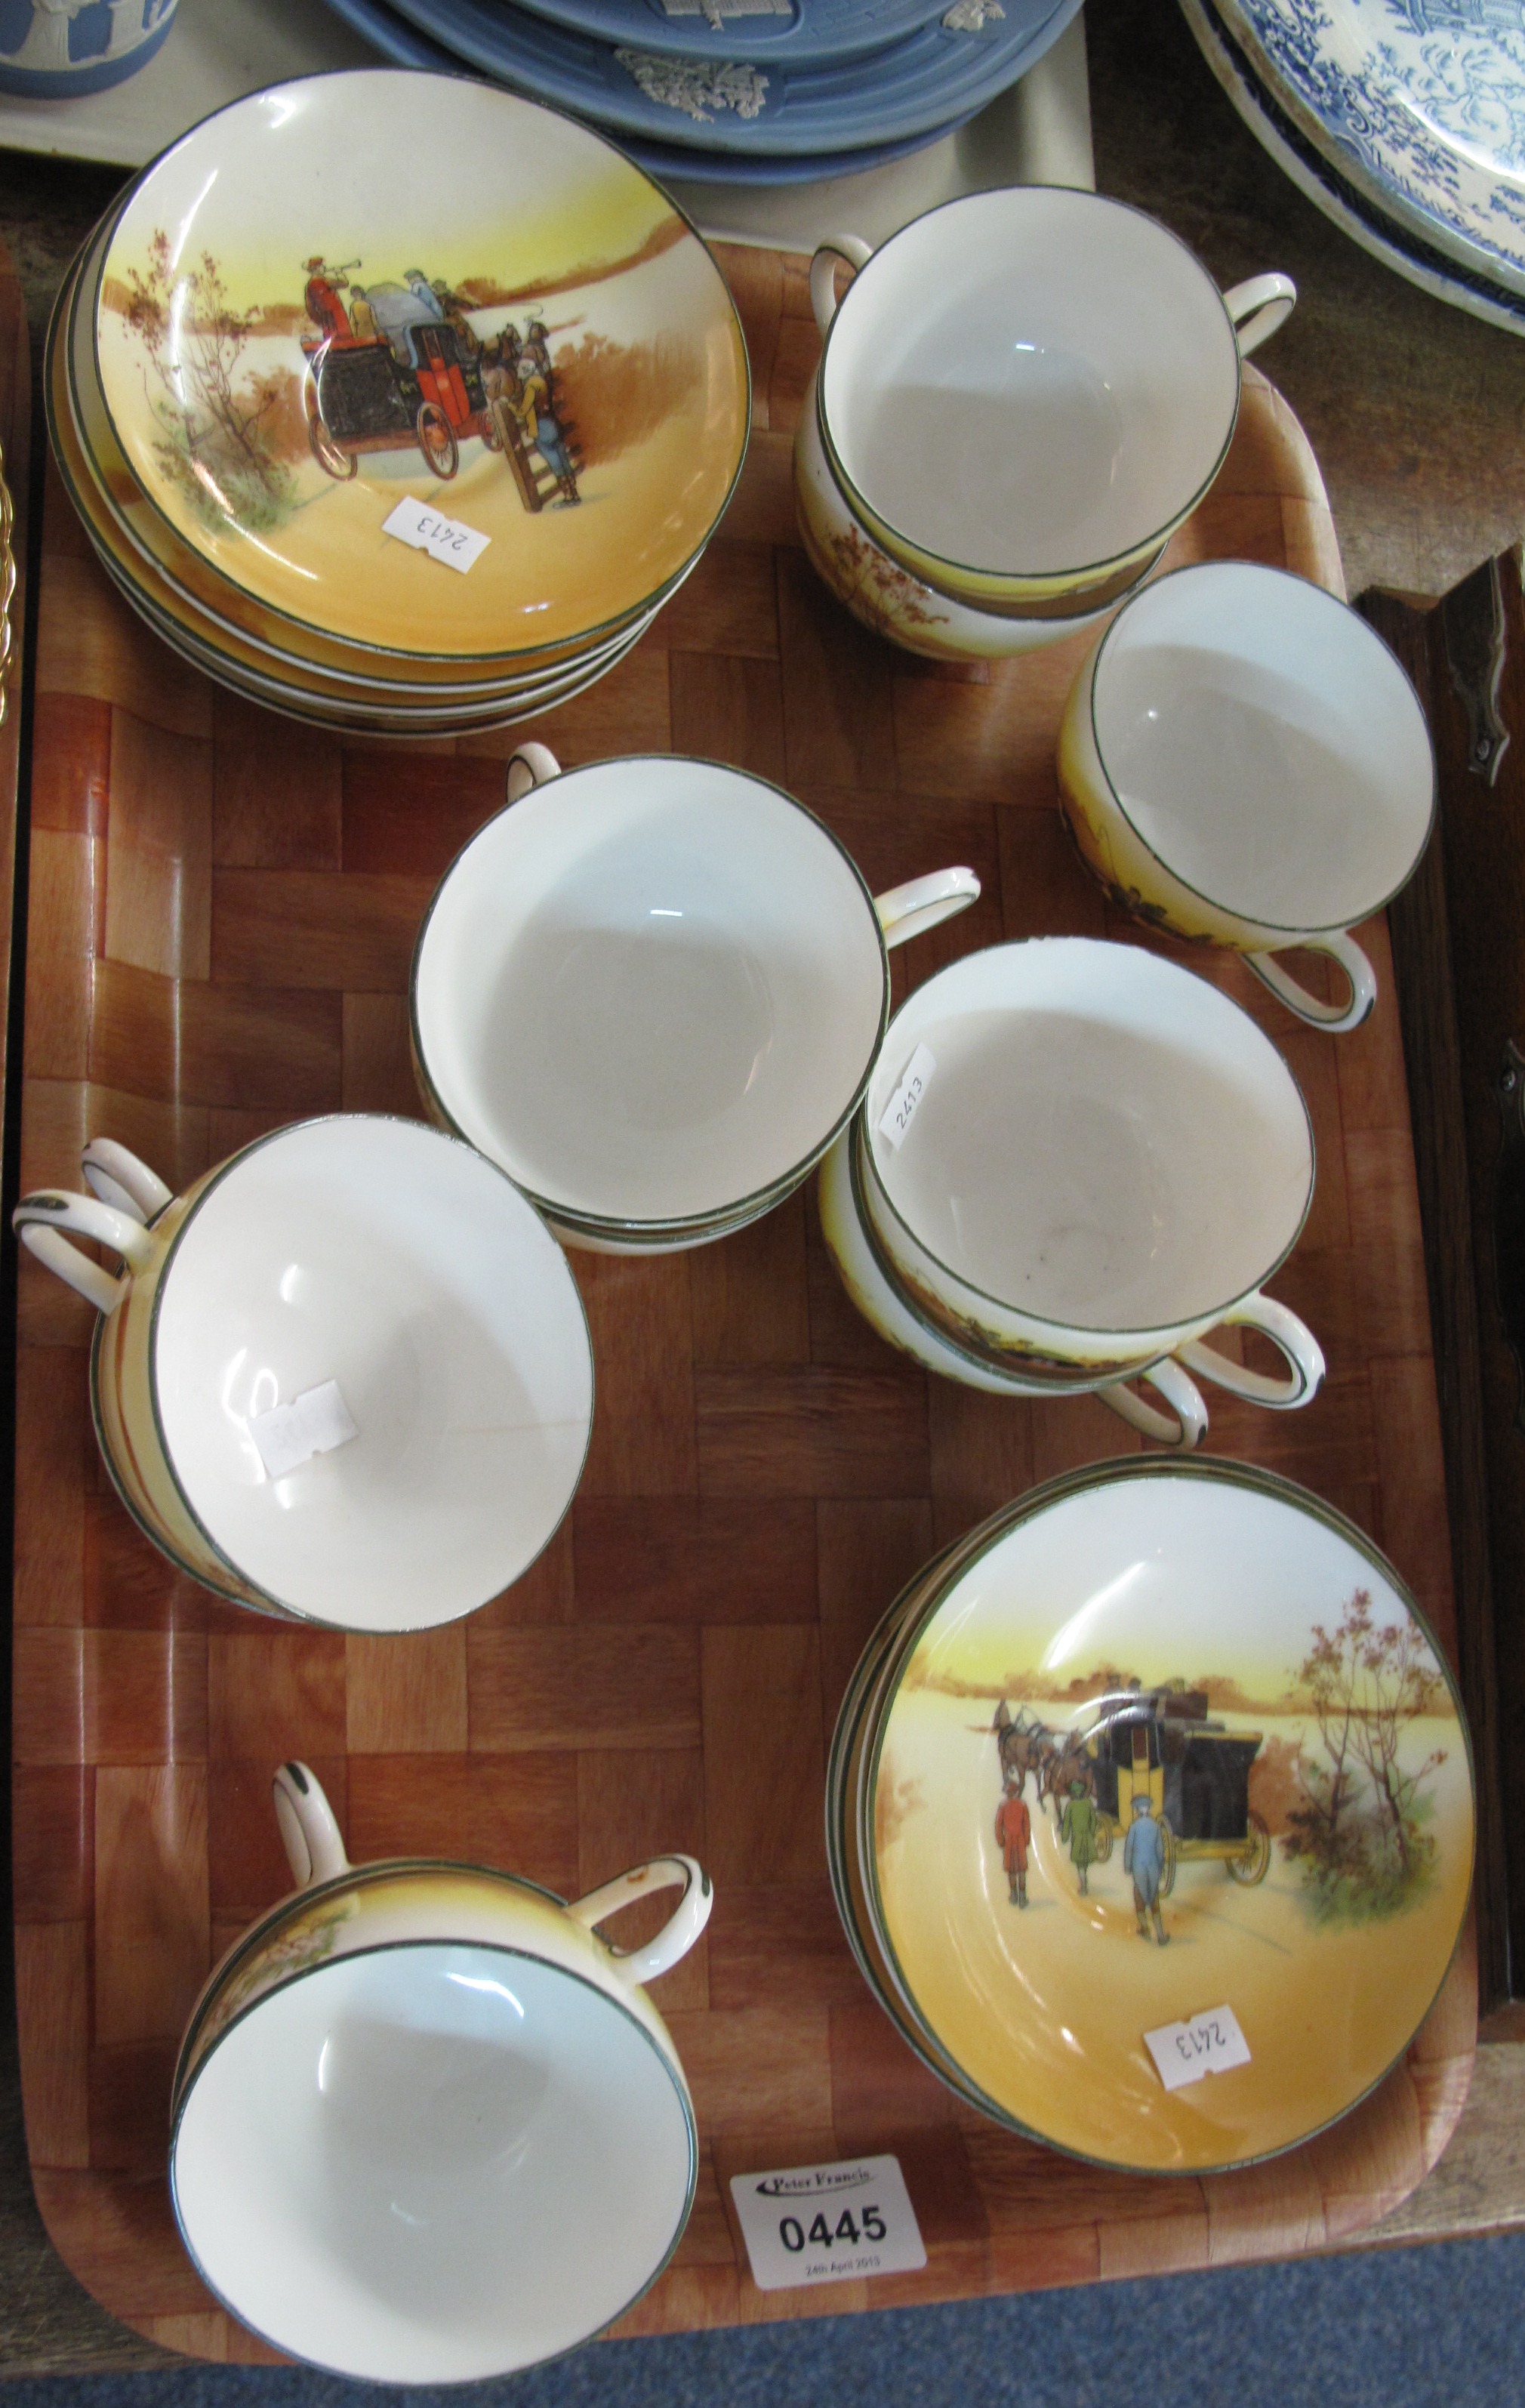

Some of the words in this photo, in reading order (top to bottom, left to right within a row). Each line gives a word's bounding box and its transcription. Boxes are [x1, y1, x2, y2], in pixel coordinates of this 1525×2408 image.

[417, 517, 468, 550] 2413
[896, 1076, 923, 1130] 2413
[1175, 2021, 1226, 2059] 2413
[765, 2175, 812, 2193] Peter
[815, 2166, 870, 2187] Francis
[778, 2204, 887, 2252] 0445
[805, 2262, 828, 2277] 24th
[830, 2258, 854, 2274] April
